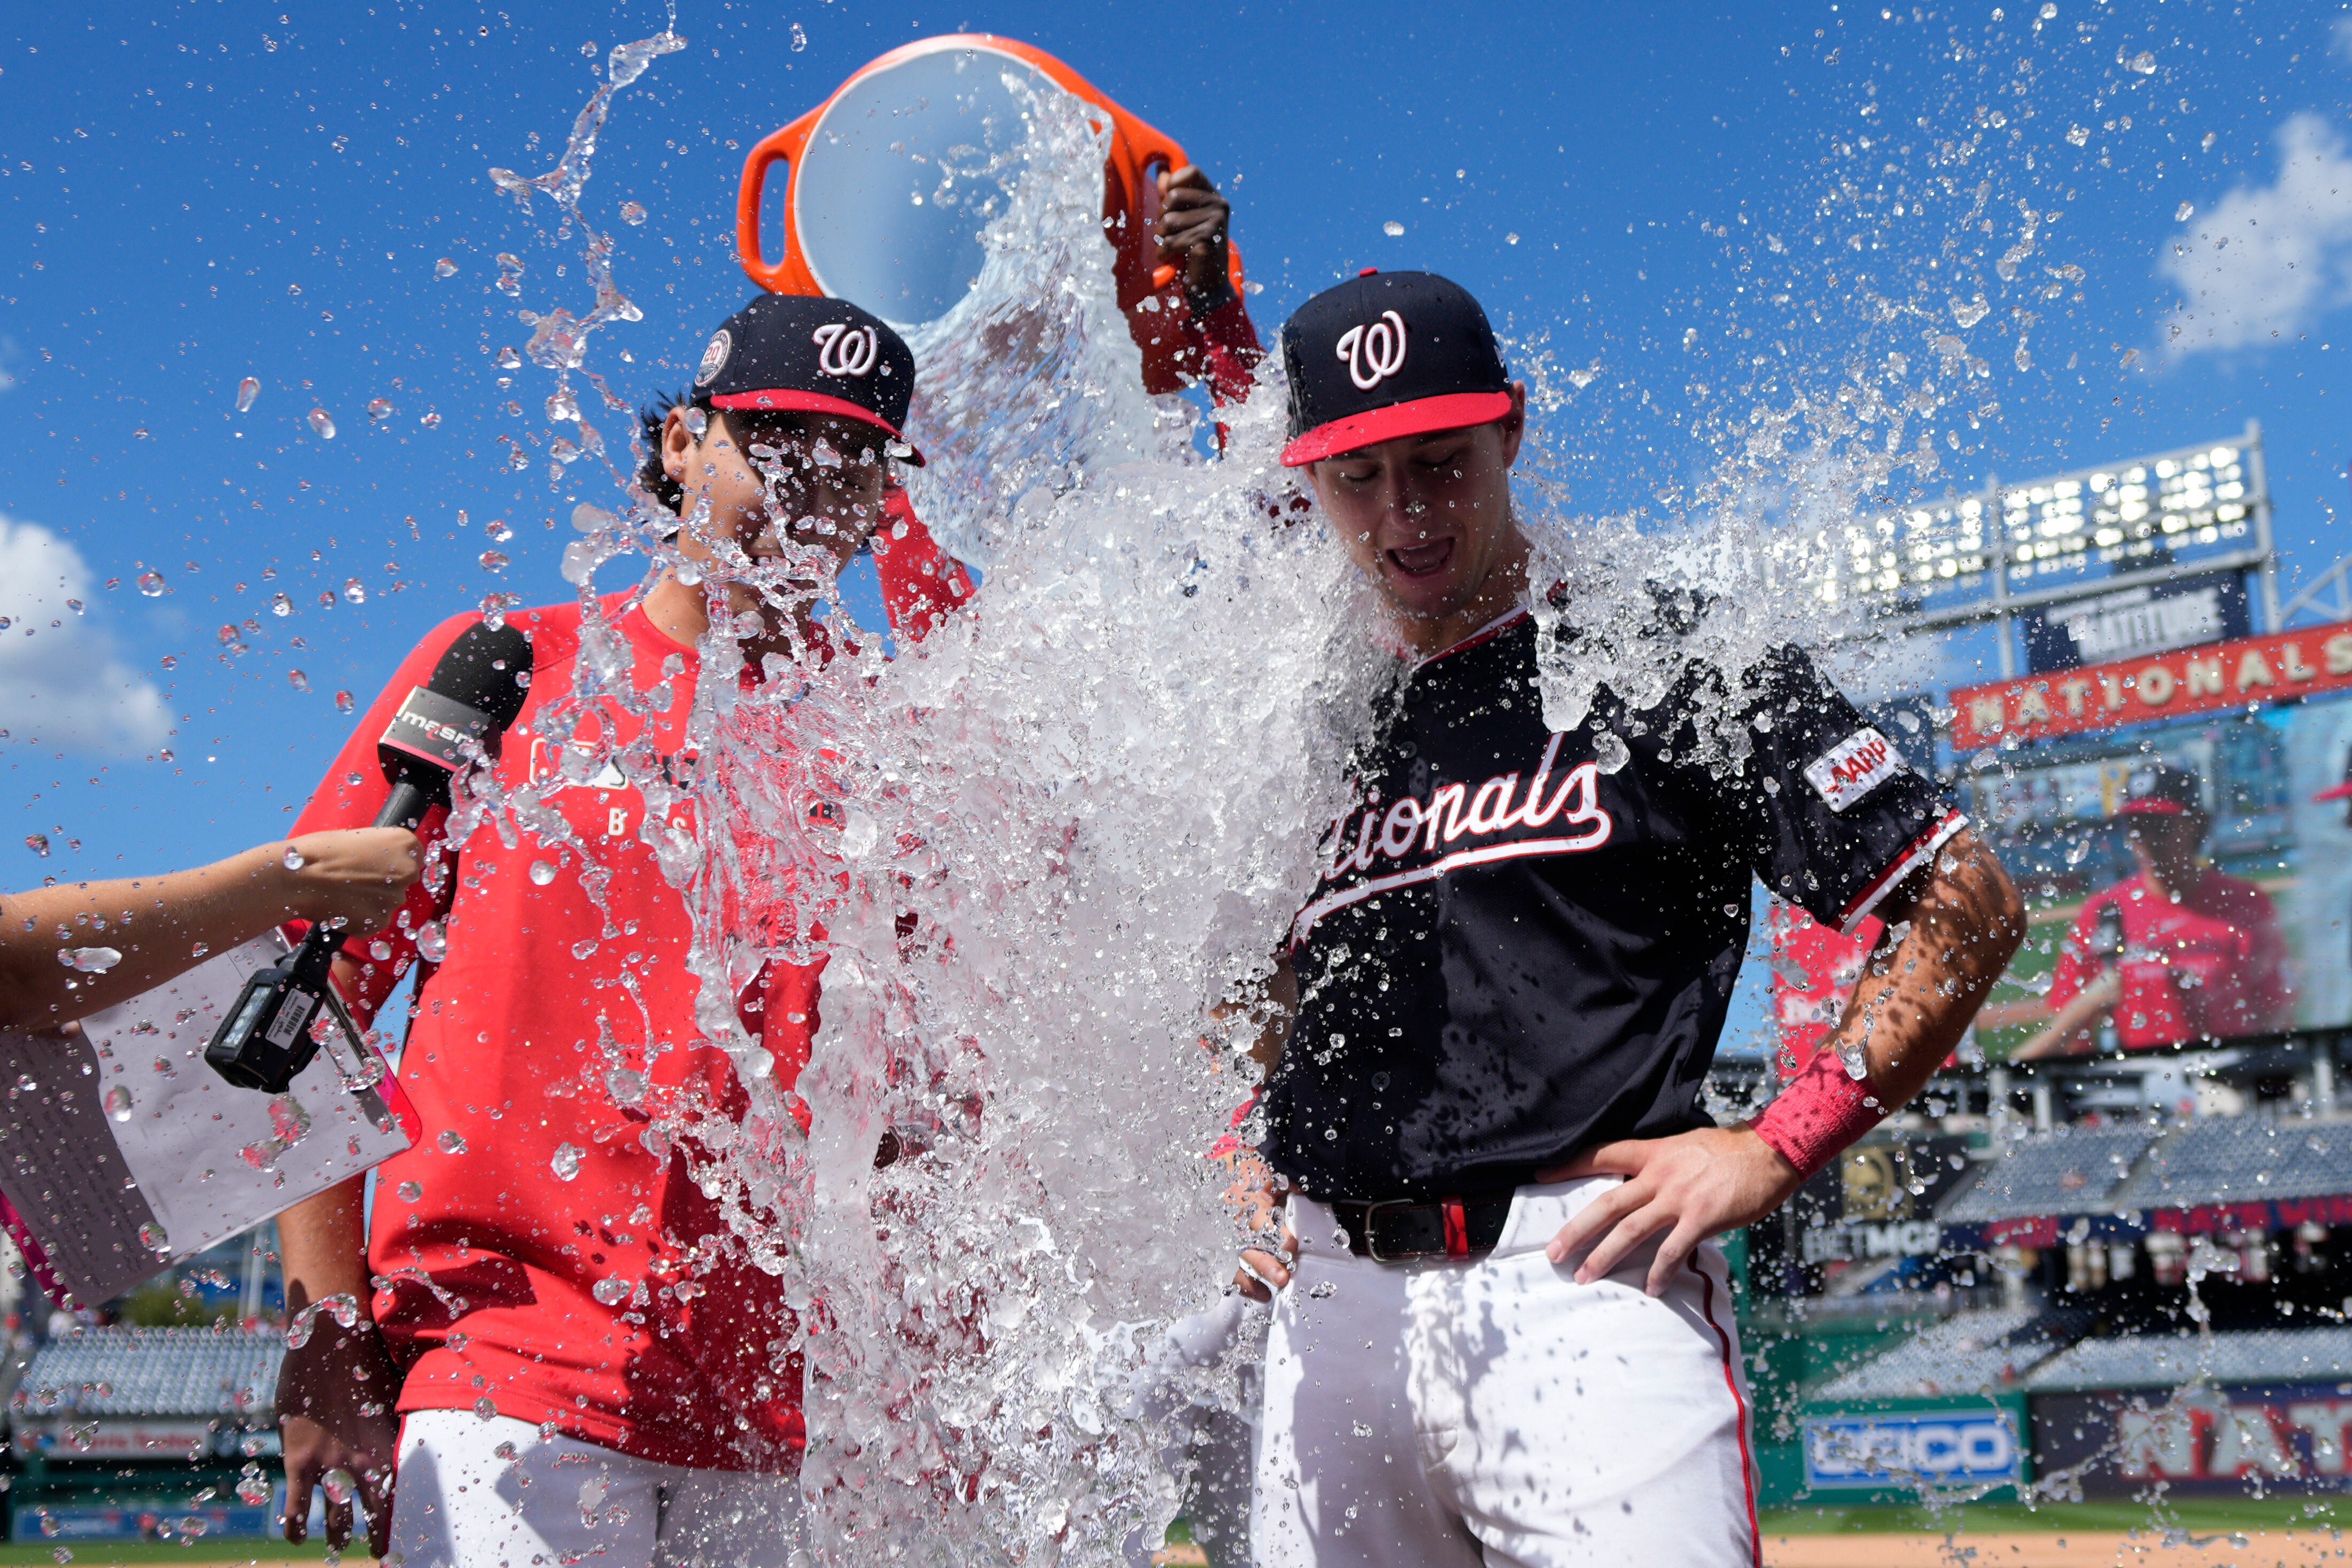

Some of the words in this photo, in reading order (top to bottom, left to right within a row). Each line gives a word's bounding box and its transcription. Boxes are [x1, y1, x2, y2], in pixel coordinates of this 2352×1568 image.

[703, 345, 720, 362] 20
[812, 323, 877, 376] W
[1336, 309, 1407, 391] W
[1969, 634, 2352, 733] NATIONALS
[1824, 740, 1887, 794] AARP
[1818, 1425, 2012, 1474] GEICO
